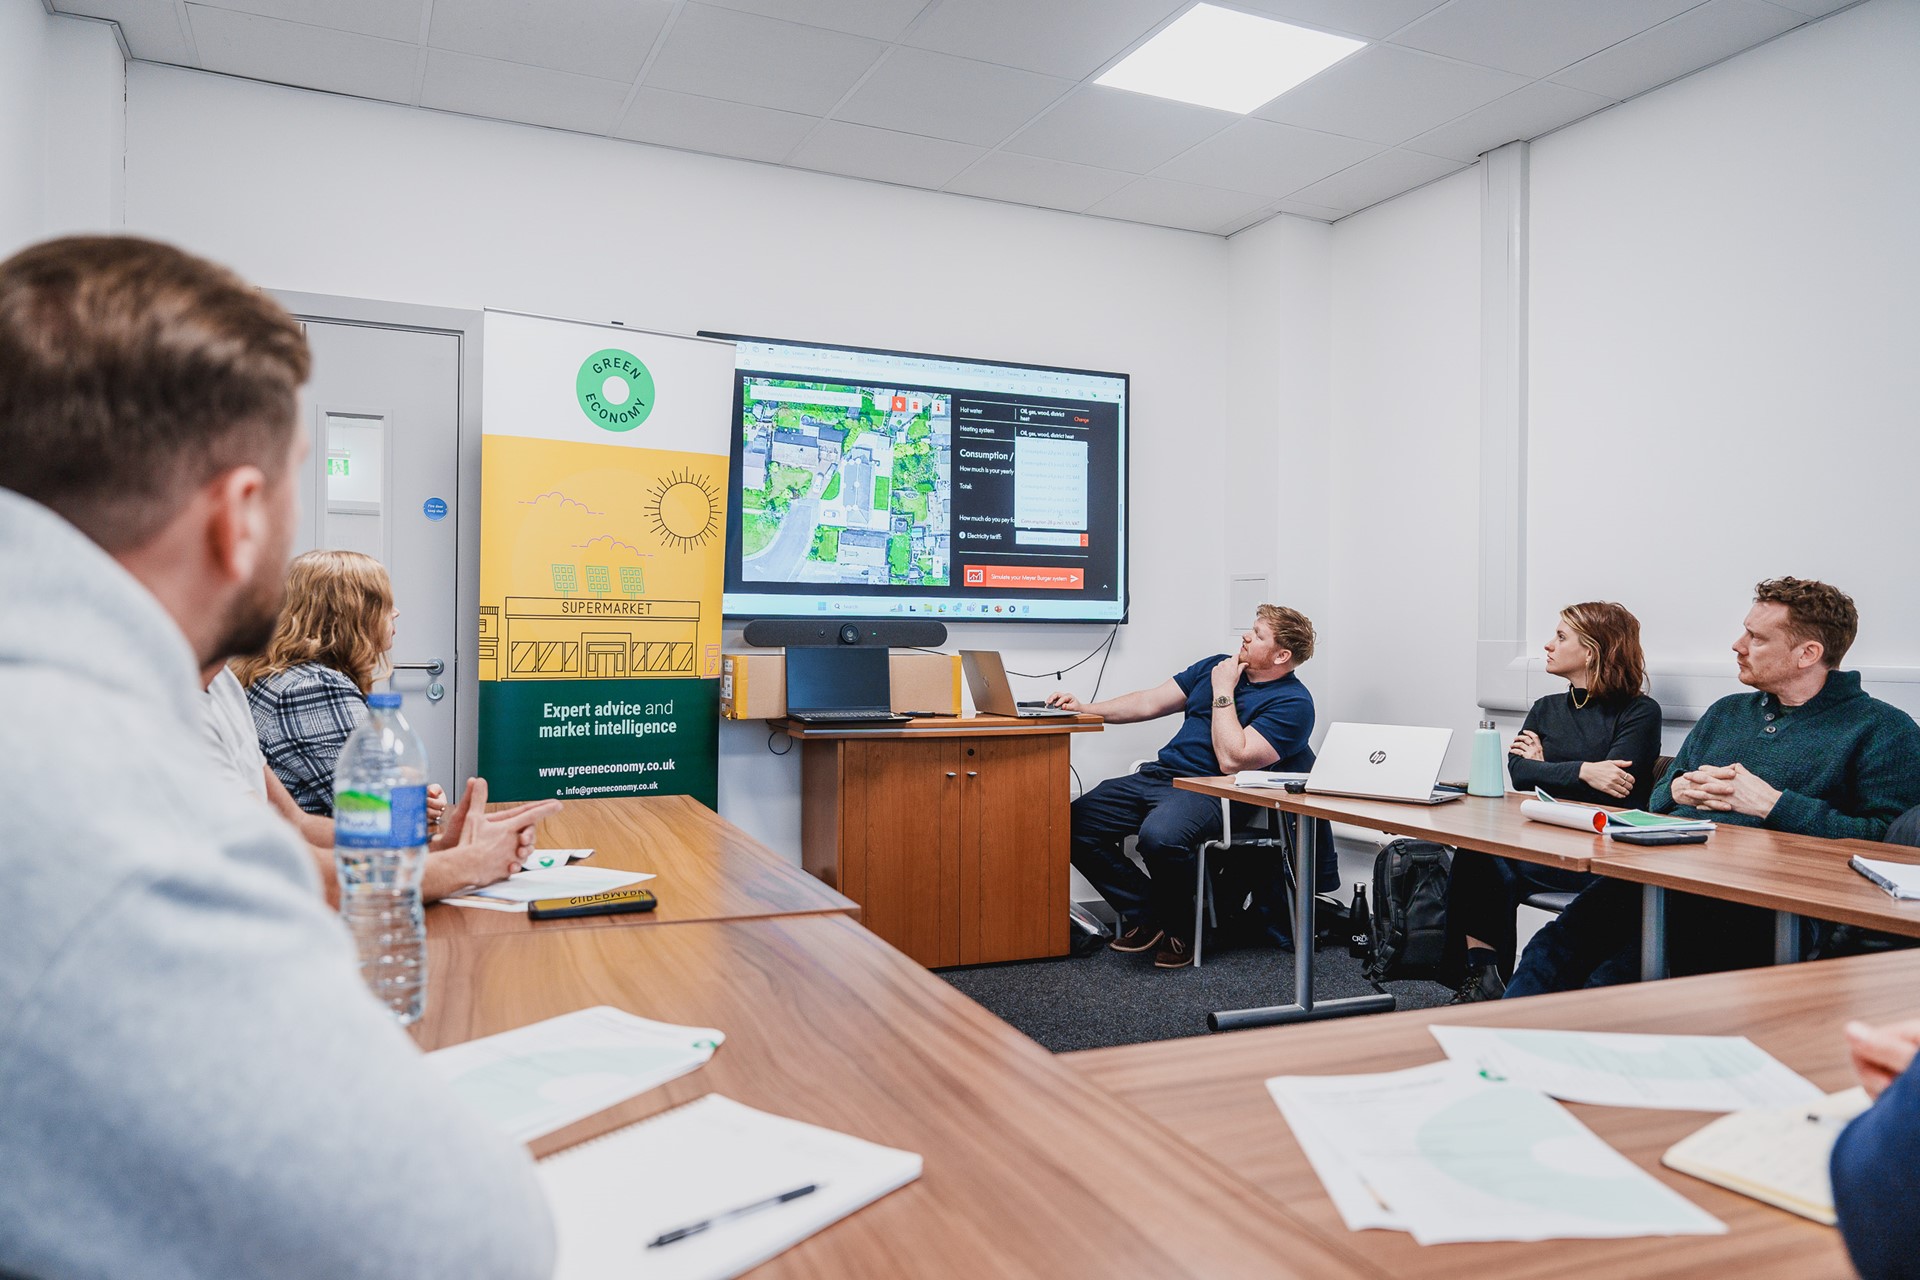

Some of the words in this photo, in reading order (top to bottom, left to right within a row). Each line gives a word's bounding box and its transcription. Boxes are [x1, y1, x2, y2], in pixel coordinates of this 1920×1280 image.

[592, 357, 641, 379] GREEN
[585, 393, 645, 423] ECONOMY
[960, 425, 978, 434] Heating
[960, 448, 1008, 461] Consumption
[562, 601, 652, 615] SUPERMARKET
[544, 702, 590, 721] Expert
[594, 700, 641, 716] advice
[645, 700, 673, 715] and
[539, 720, 590, 738] market
[594, 719, 677, 738] intelligence
[1369, 750, 1387, 764] hp
[539, 758, 676, 778] www.greeneconomy.co.uk
[556, 787, 564, 795] e.
[565, 781, 658, 796] info@greeneconomy.co.uk
